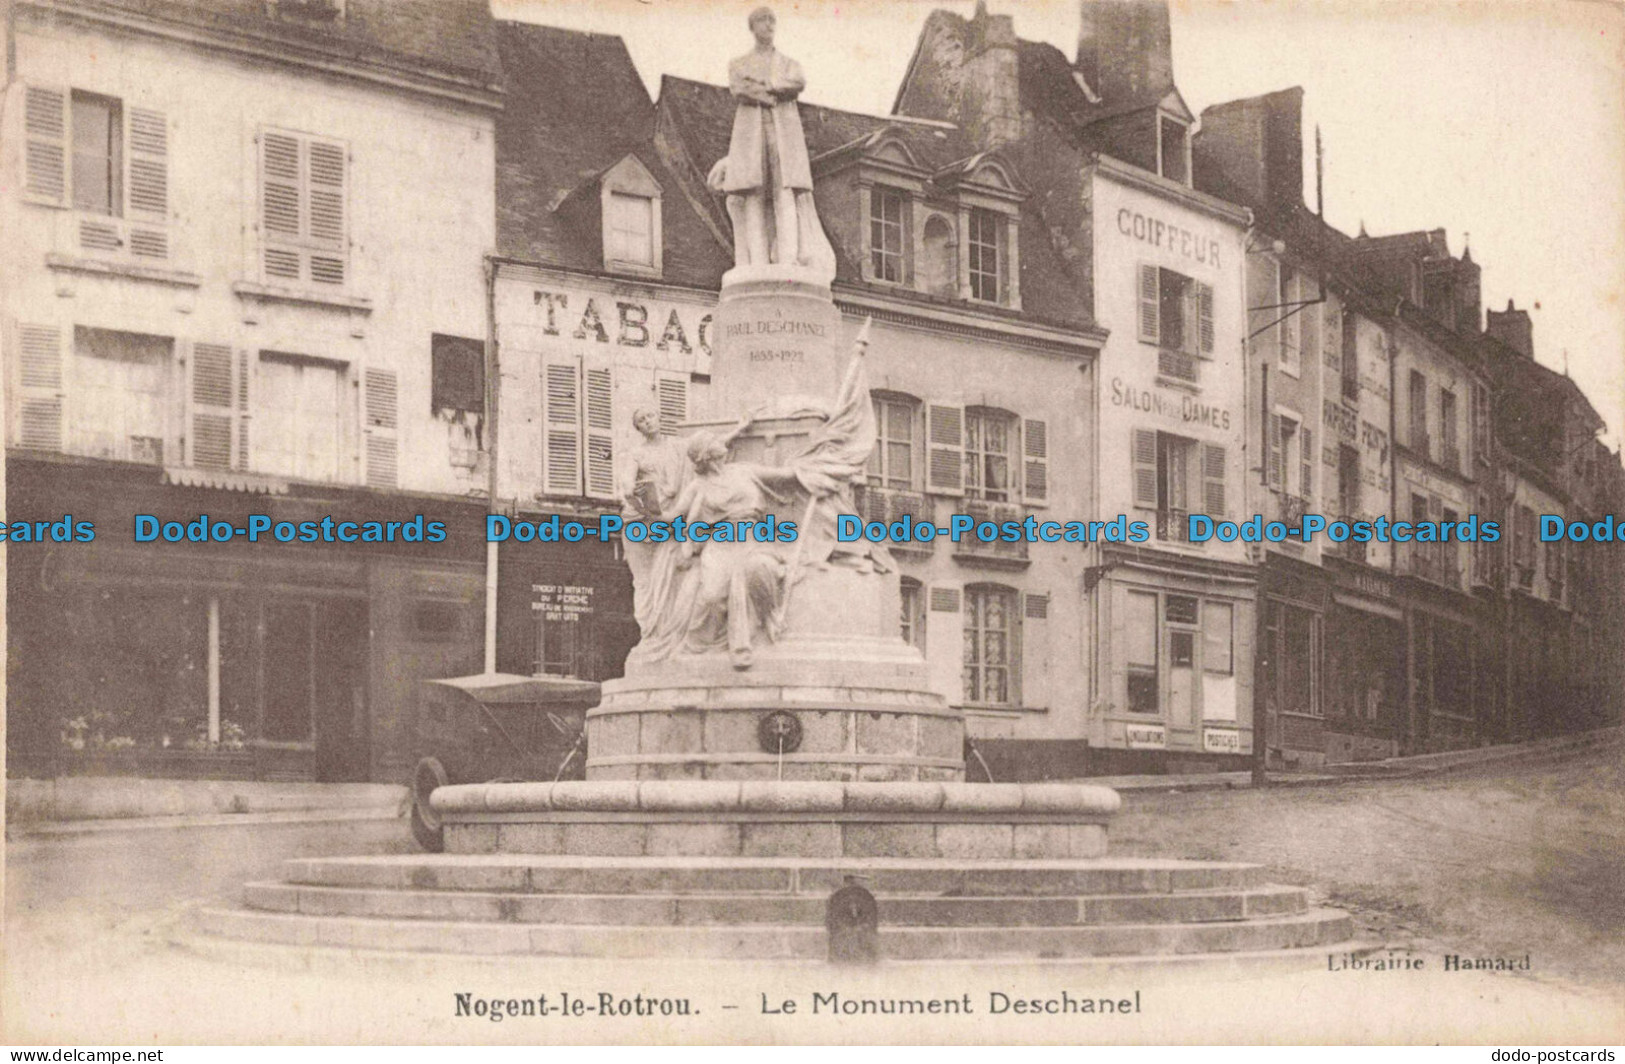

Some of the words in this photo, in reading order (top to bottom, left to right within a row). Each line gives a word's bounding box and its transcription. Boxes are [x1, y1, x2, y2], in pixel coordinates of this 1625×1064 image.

[1117, 208, 1221, 269] COIFFEUR
[726, 322, 754, 337] PAUL
[757, 320, 825, 337] DESCHANEL
[1111, 377, 1162, 414] SALON
[1182, 396, 1230, 430] DAMES
